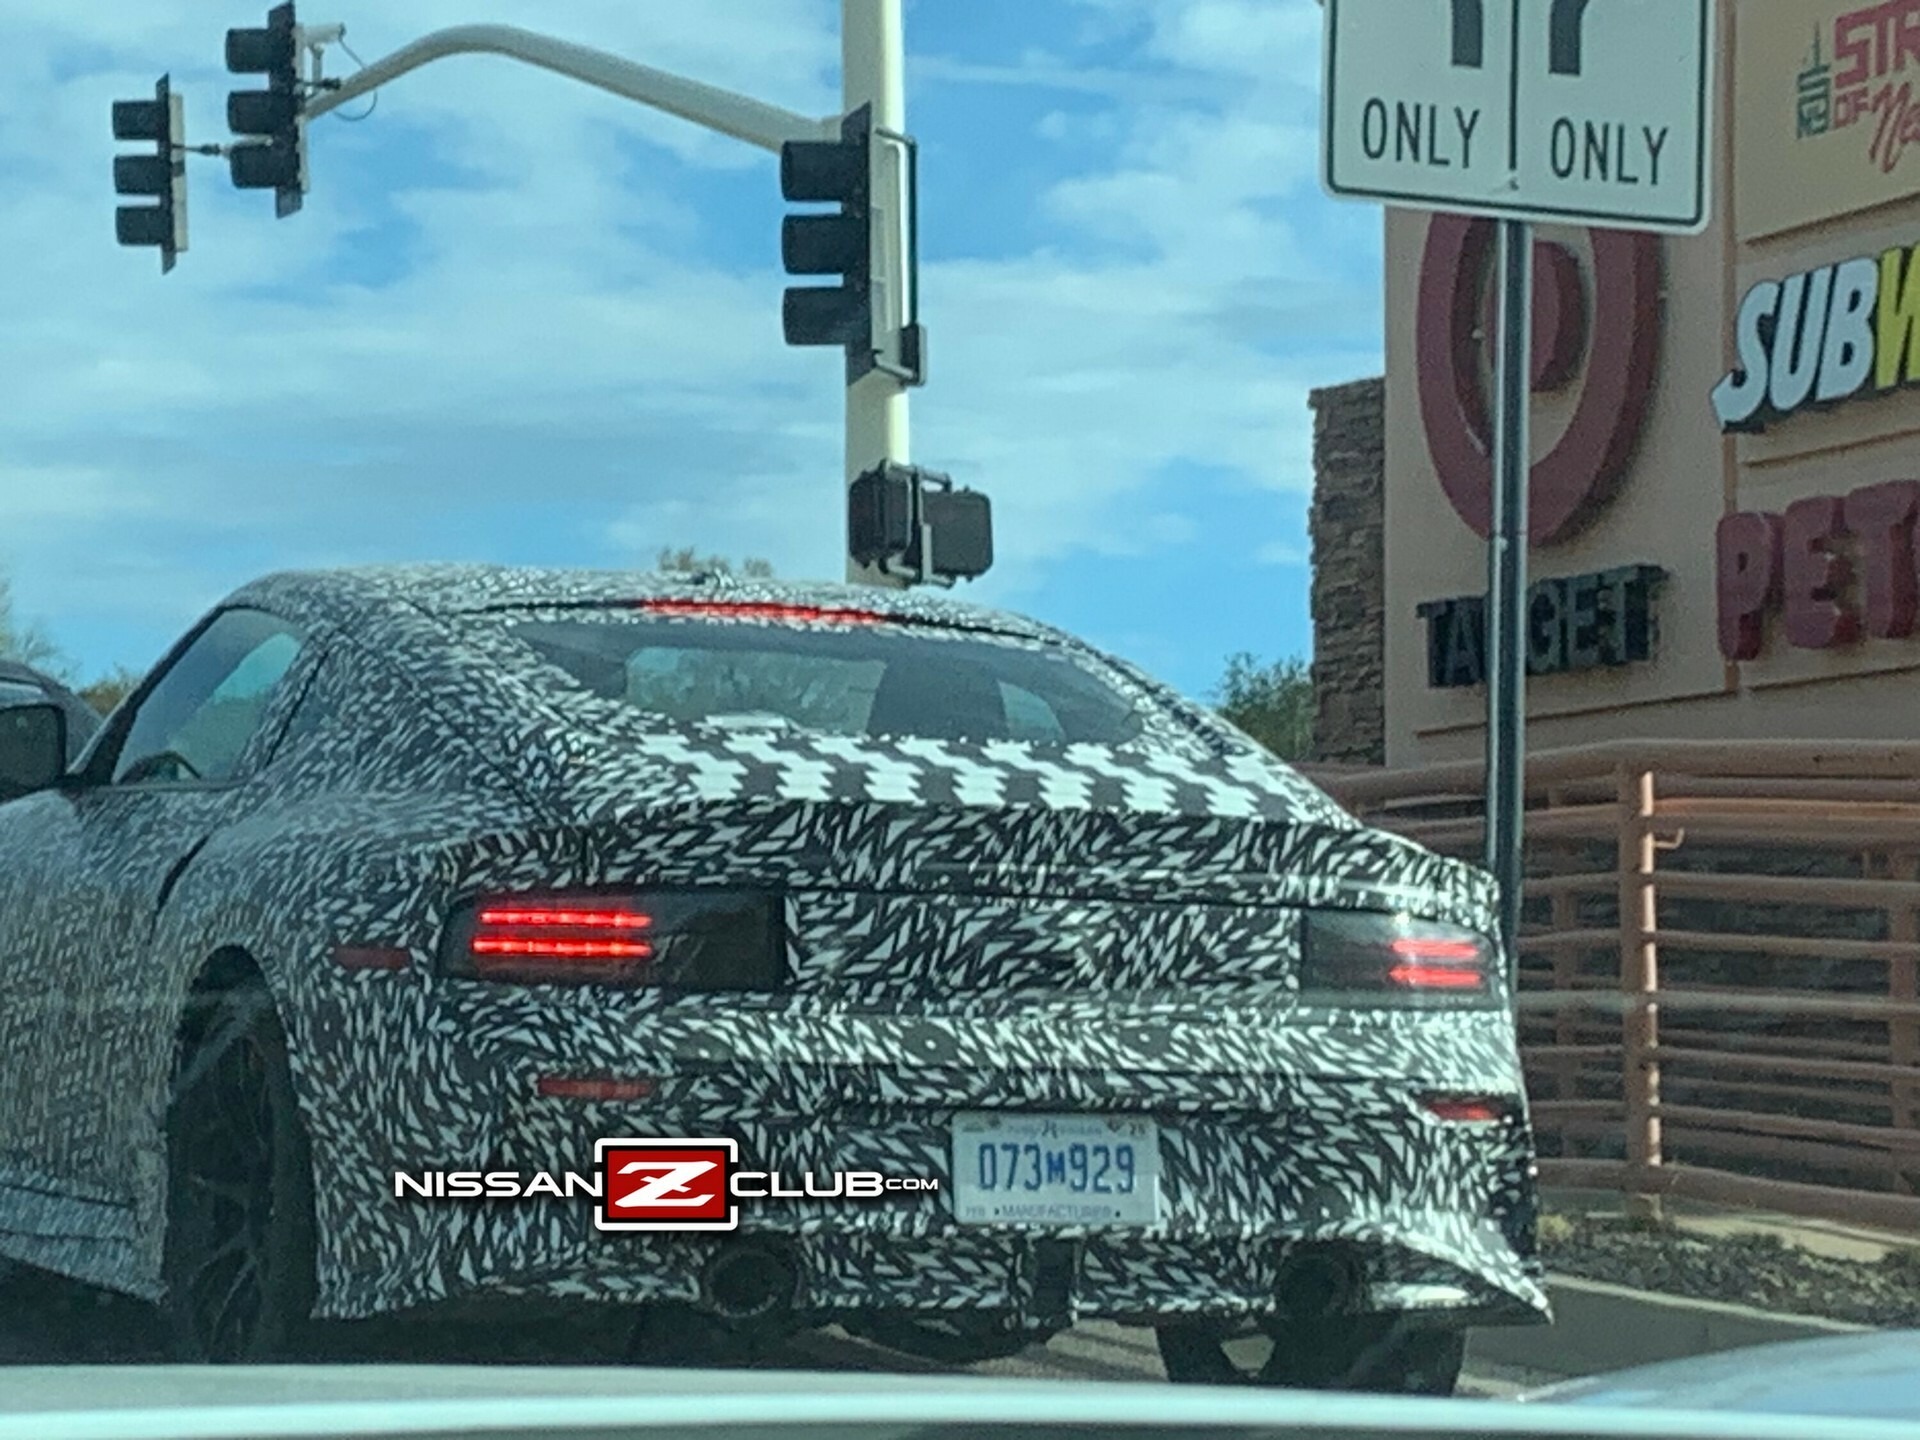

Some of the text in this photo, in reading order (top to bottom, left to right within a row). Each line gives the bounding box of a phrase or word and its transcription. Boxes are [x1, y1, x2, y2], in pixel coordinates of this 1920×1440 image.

[1361, 97, 1481, 169] ONLY
[1834, 87, 1869, 131] OF
[1548, 116, 1670, 186] ONLY
[1716, 480, 1920, 662] PET
[1415, 563, 1666, 690] TAGET
[978, 1141, 1136, 1194] 073M929
